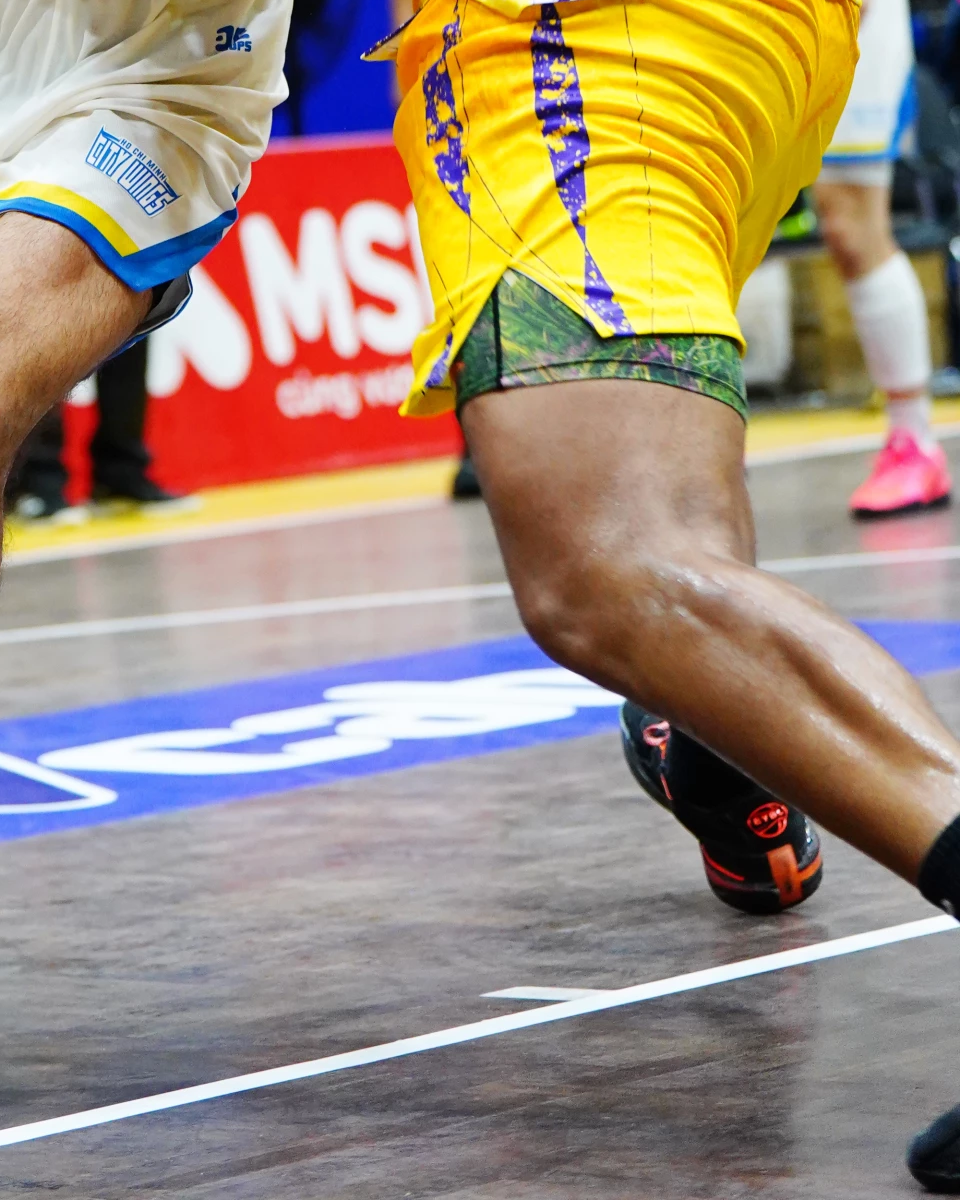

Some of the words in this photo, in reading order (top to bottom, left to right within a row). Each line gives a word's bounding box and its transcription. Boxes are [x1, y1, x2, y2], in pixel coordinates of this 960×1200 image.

[85, 127, 133, 177] CITY
[117, 158, 183, 217] WINGS
[120, 138, 133, 150] HO
[132, 147, 147, 161] CHI
[146, 159, 168, 183] MINH
